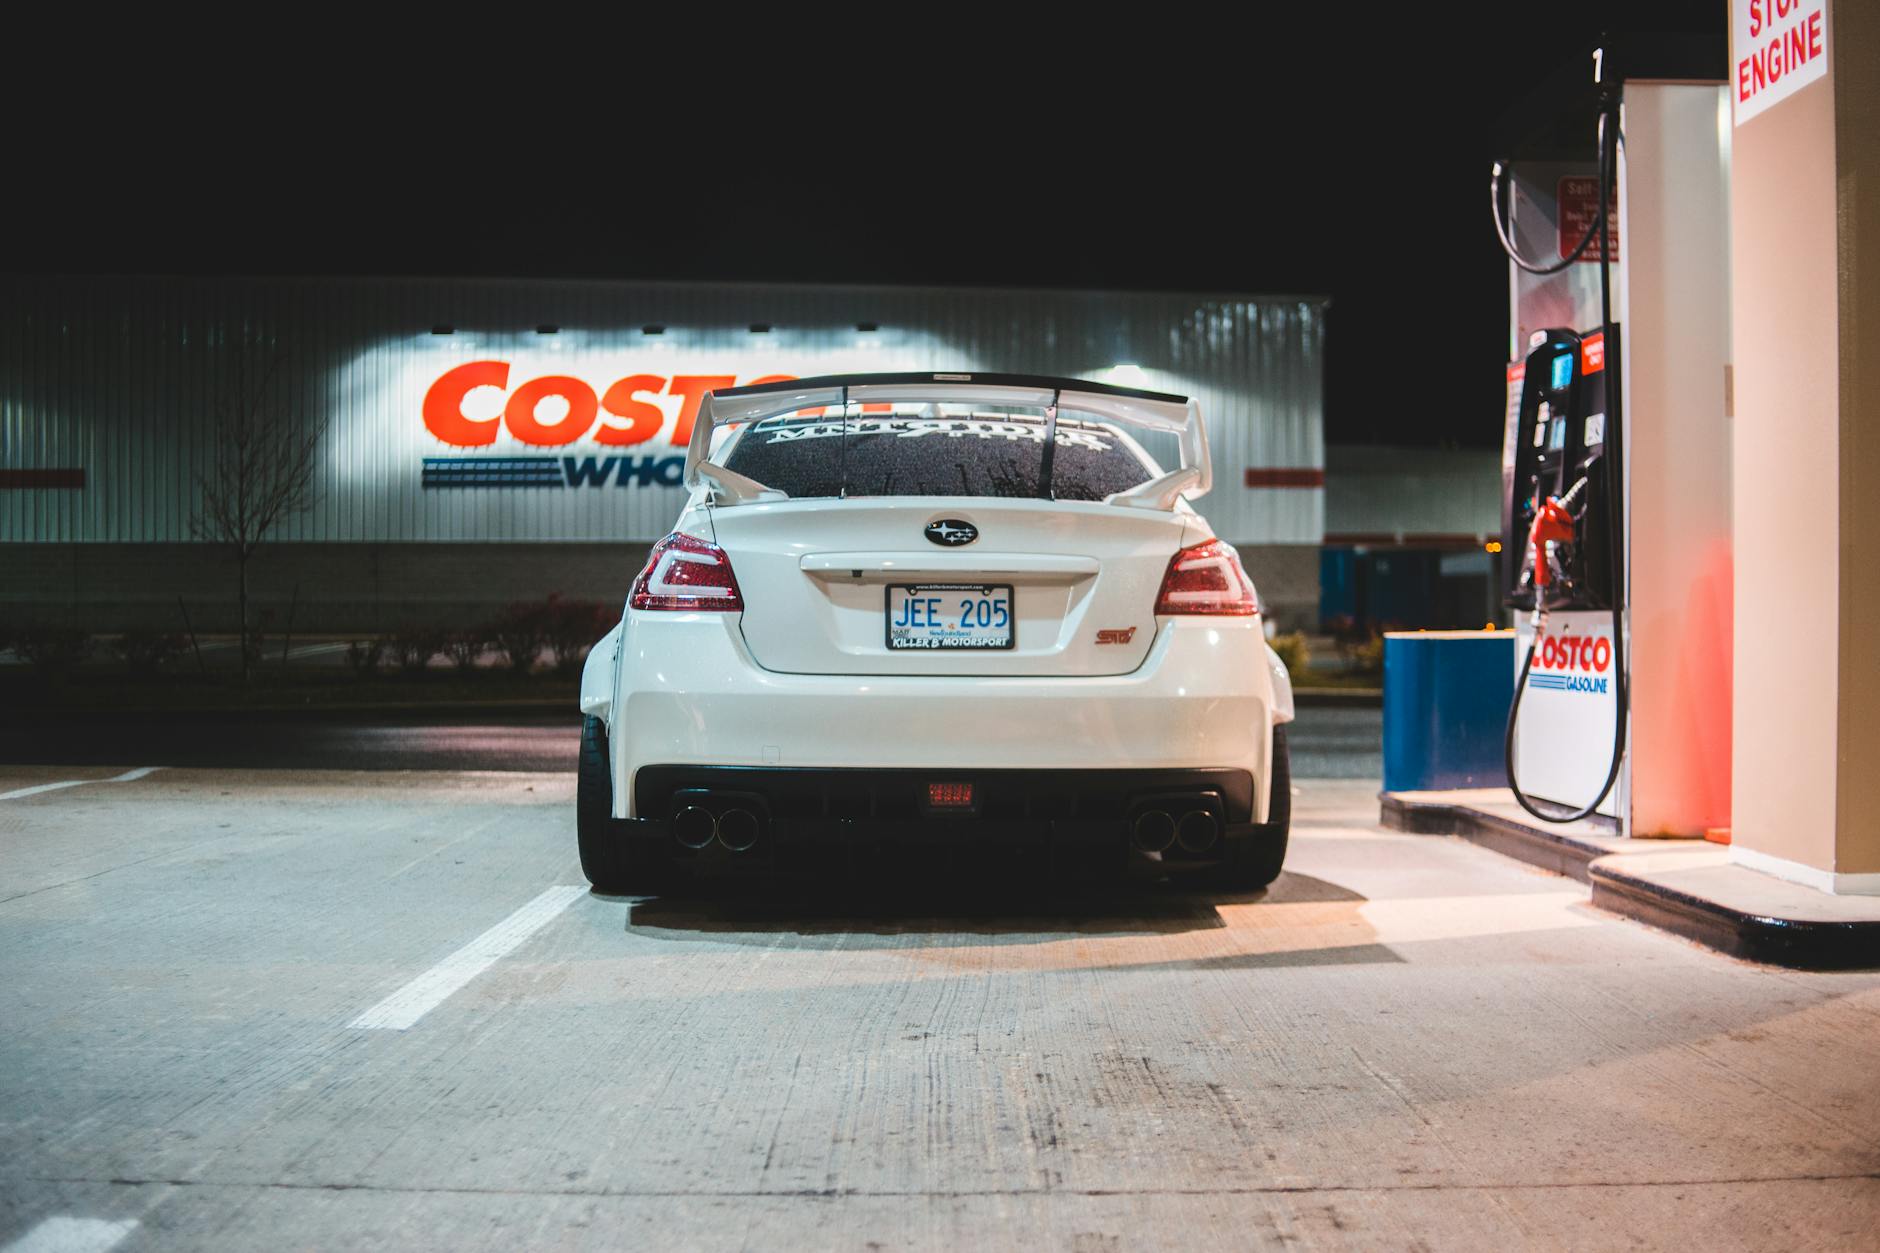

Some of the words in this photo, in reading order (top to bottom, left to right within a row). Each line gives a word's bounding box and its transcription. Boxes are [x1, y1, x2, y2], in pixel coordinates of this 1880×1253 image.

[1593, 47, 1603, 83] 1
[1739, 9, 1822, 103] ENGINE
[895, 598, 942, 627] JEE
[960, 599, 1008, 627] 205
[893, 638, 929, 648] KILLER
[931, 638, 940, 648] B
[942, 638, 1007, 647] MOTORSPORT
[1566, 676, 1608, 694] GASOLINE
